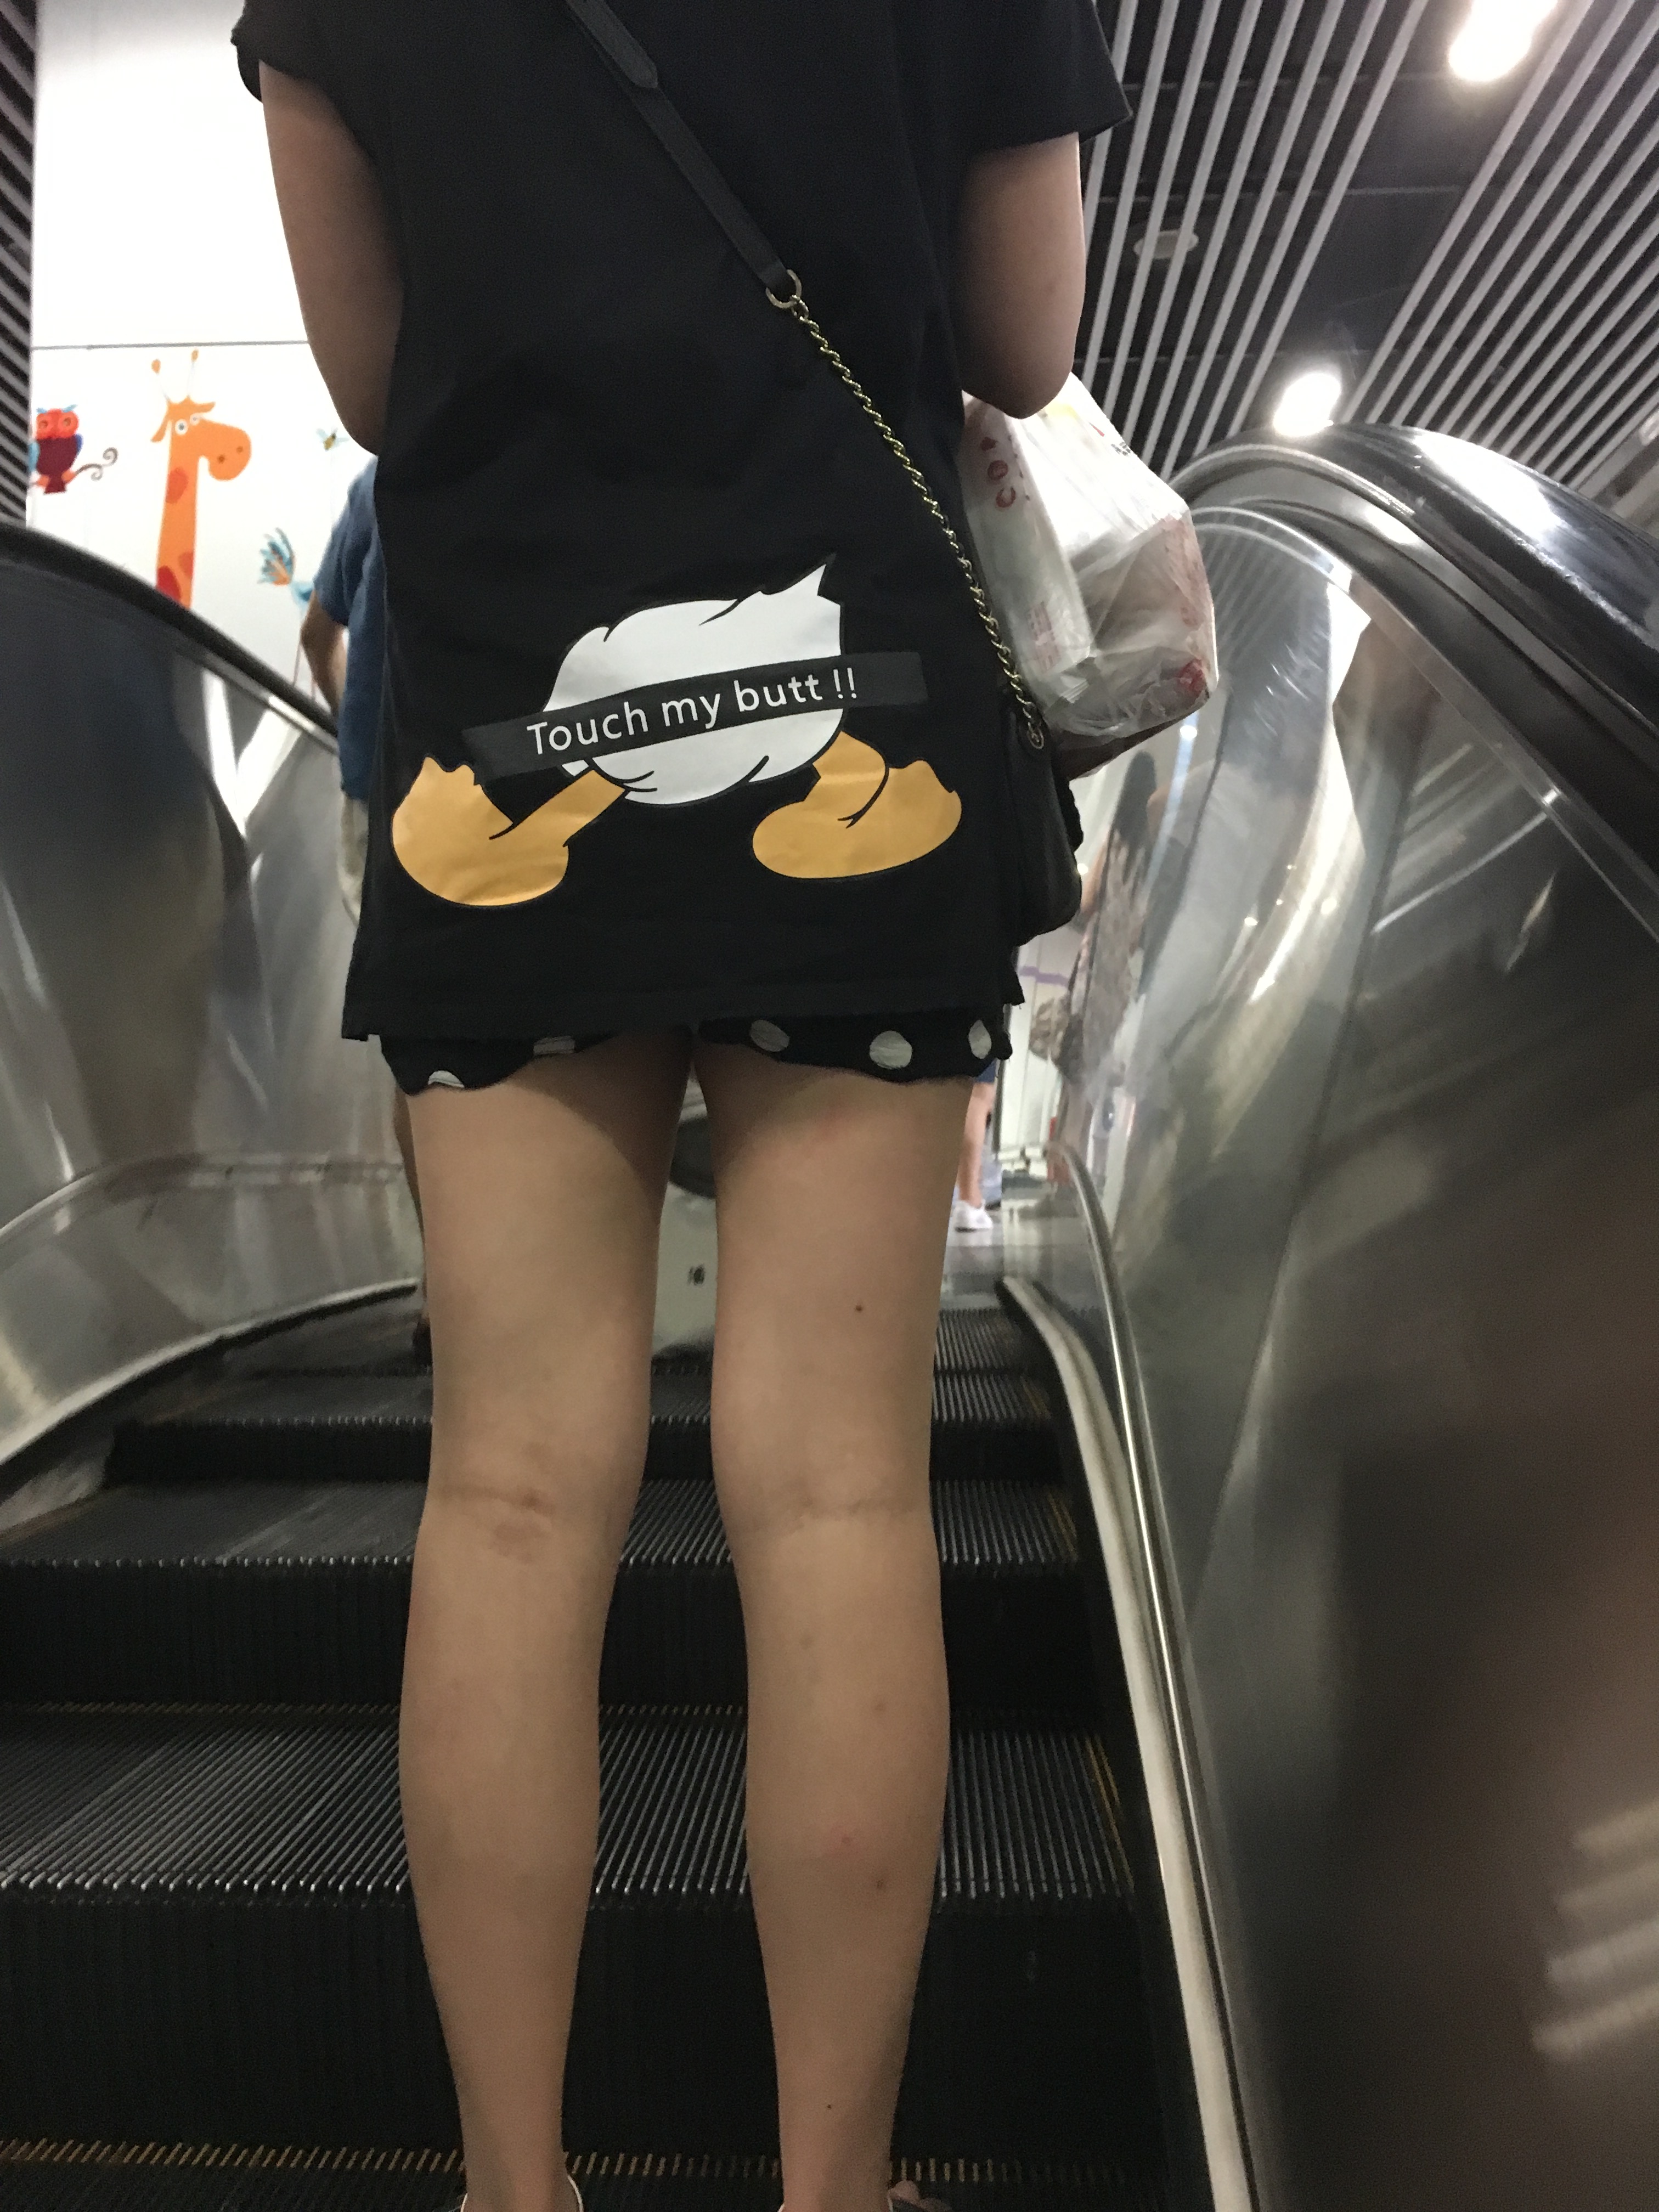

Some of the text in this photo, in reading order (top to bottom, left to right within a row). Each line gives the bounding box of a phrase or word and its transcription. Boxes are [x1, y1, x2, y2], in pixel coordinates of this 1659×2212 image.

[526, 667, 858, 755] Touch my butt !!
